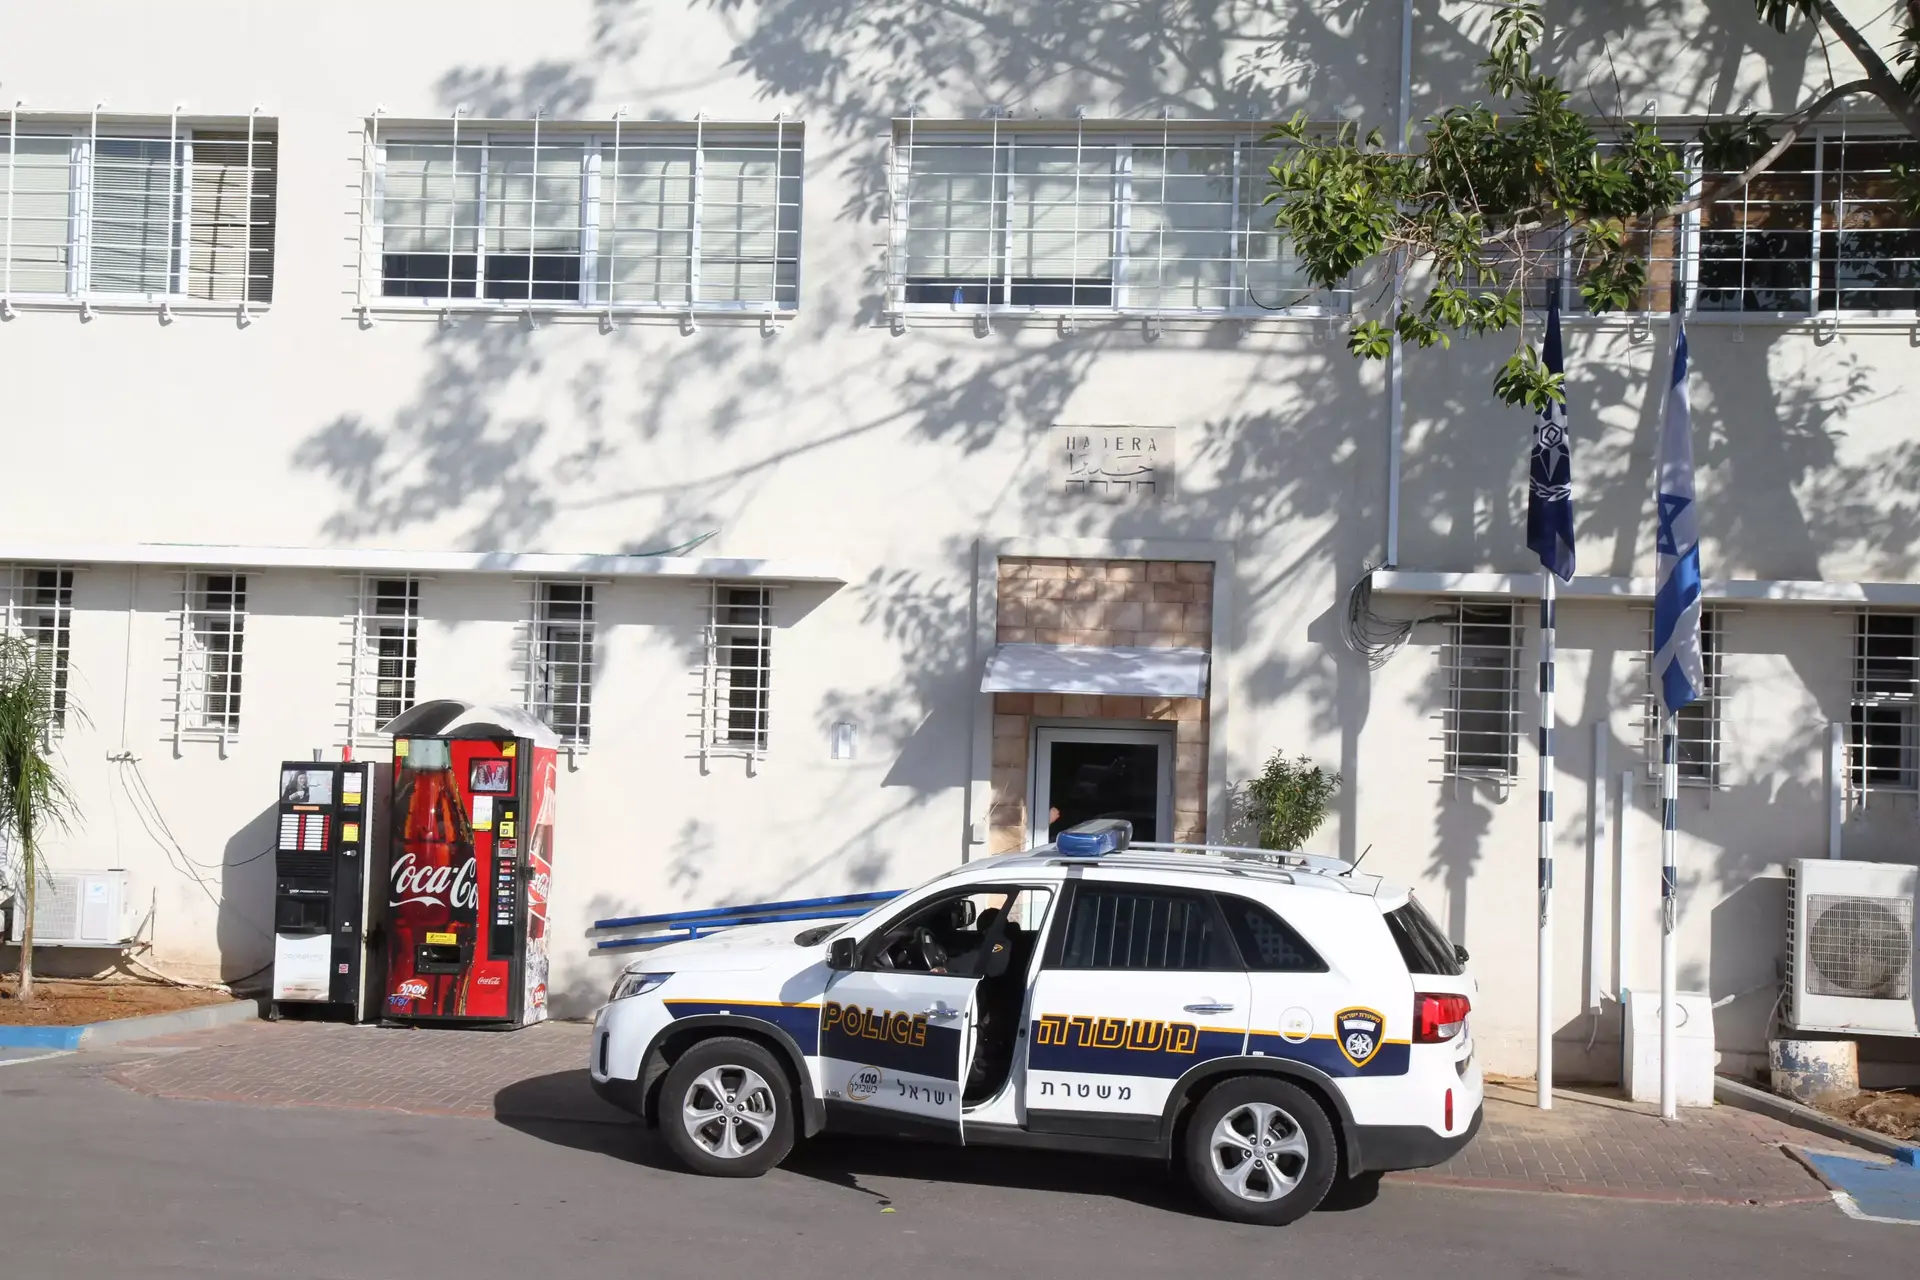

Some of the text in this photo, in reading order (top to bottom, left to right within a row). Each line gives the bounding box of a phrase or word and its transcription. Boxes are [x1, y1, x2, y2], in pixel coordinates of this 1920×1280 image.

[821, 1000, 928, 1047] POLICE
[1037, 1013, 1199, 1054] משטרה
[860, 1073, 877, 1084] 100
[1041, 1081, 1131, 1100] משטרת
[897, 1079, 952, 1105] ישראל
